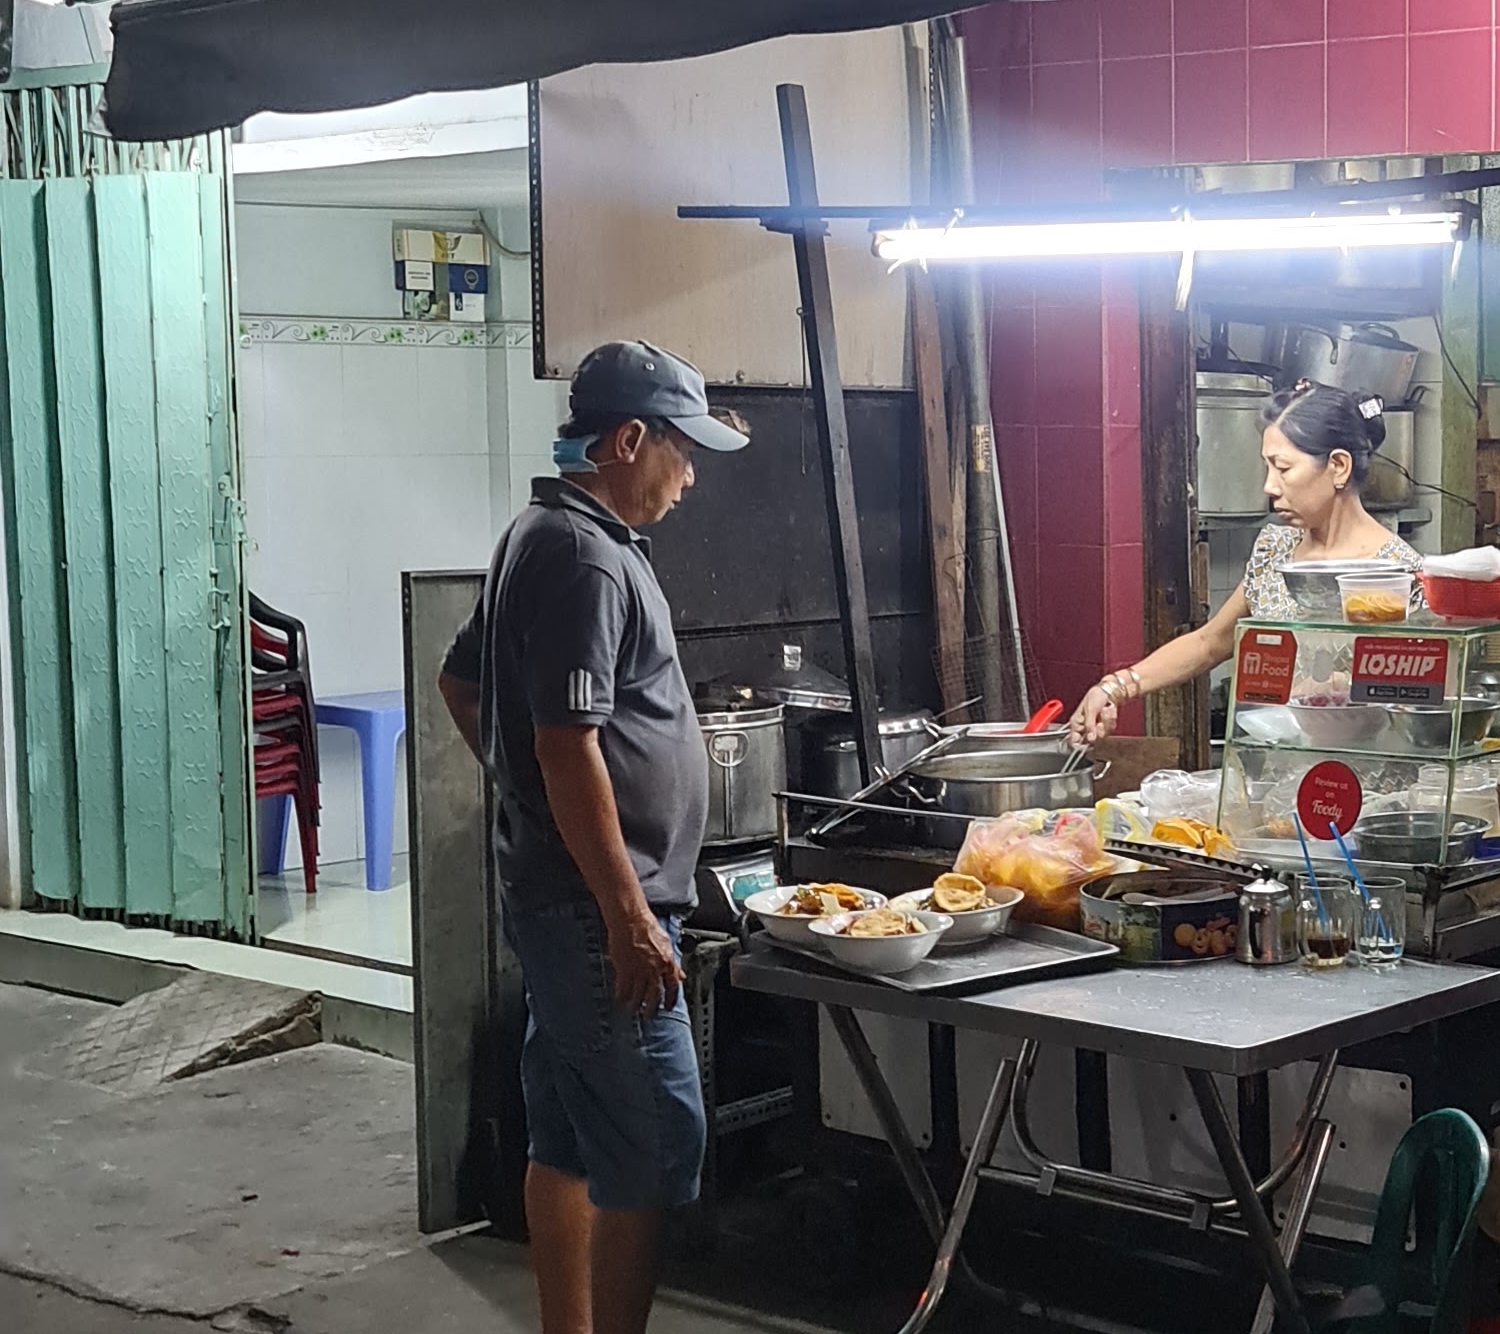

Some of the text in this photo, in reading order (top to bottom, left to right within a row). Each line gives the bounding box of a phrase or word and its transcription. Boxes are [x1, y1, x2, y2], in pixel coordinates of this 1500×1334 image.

[1261, 663, 1290, 677] Food
[1358, 653, 1438, 677] LOSHIP
[1312, 799, 1343, 822] Foody
